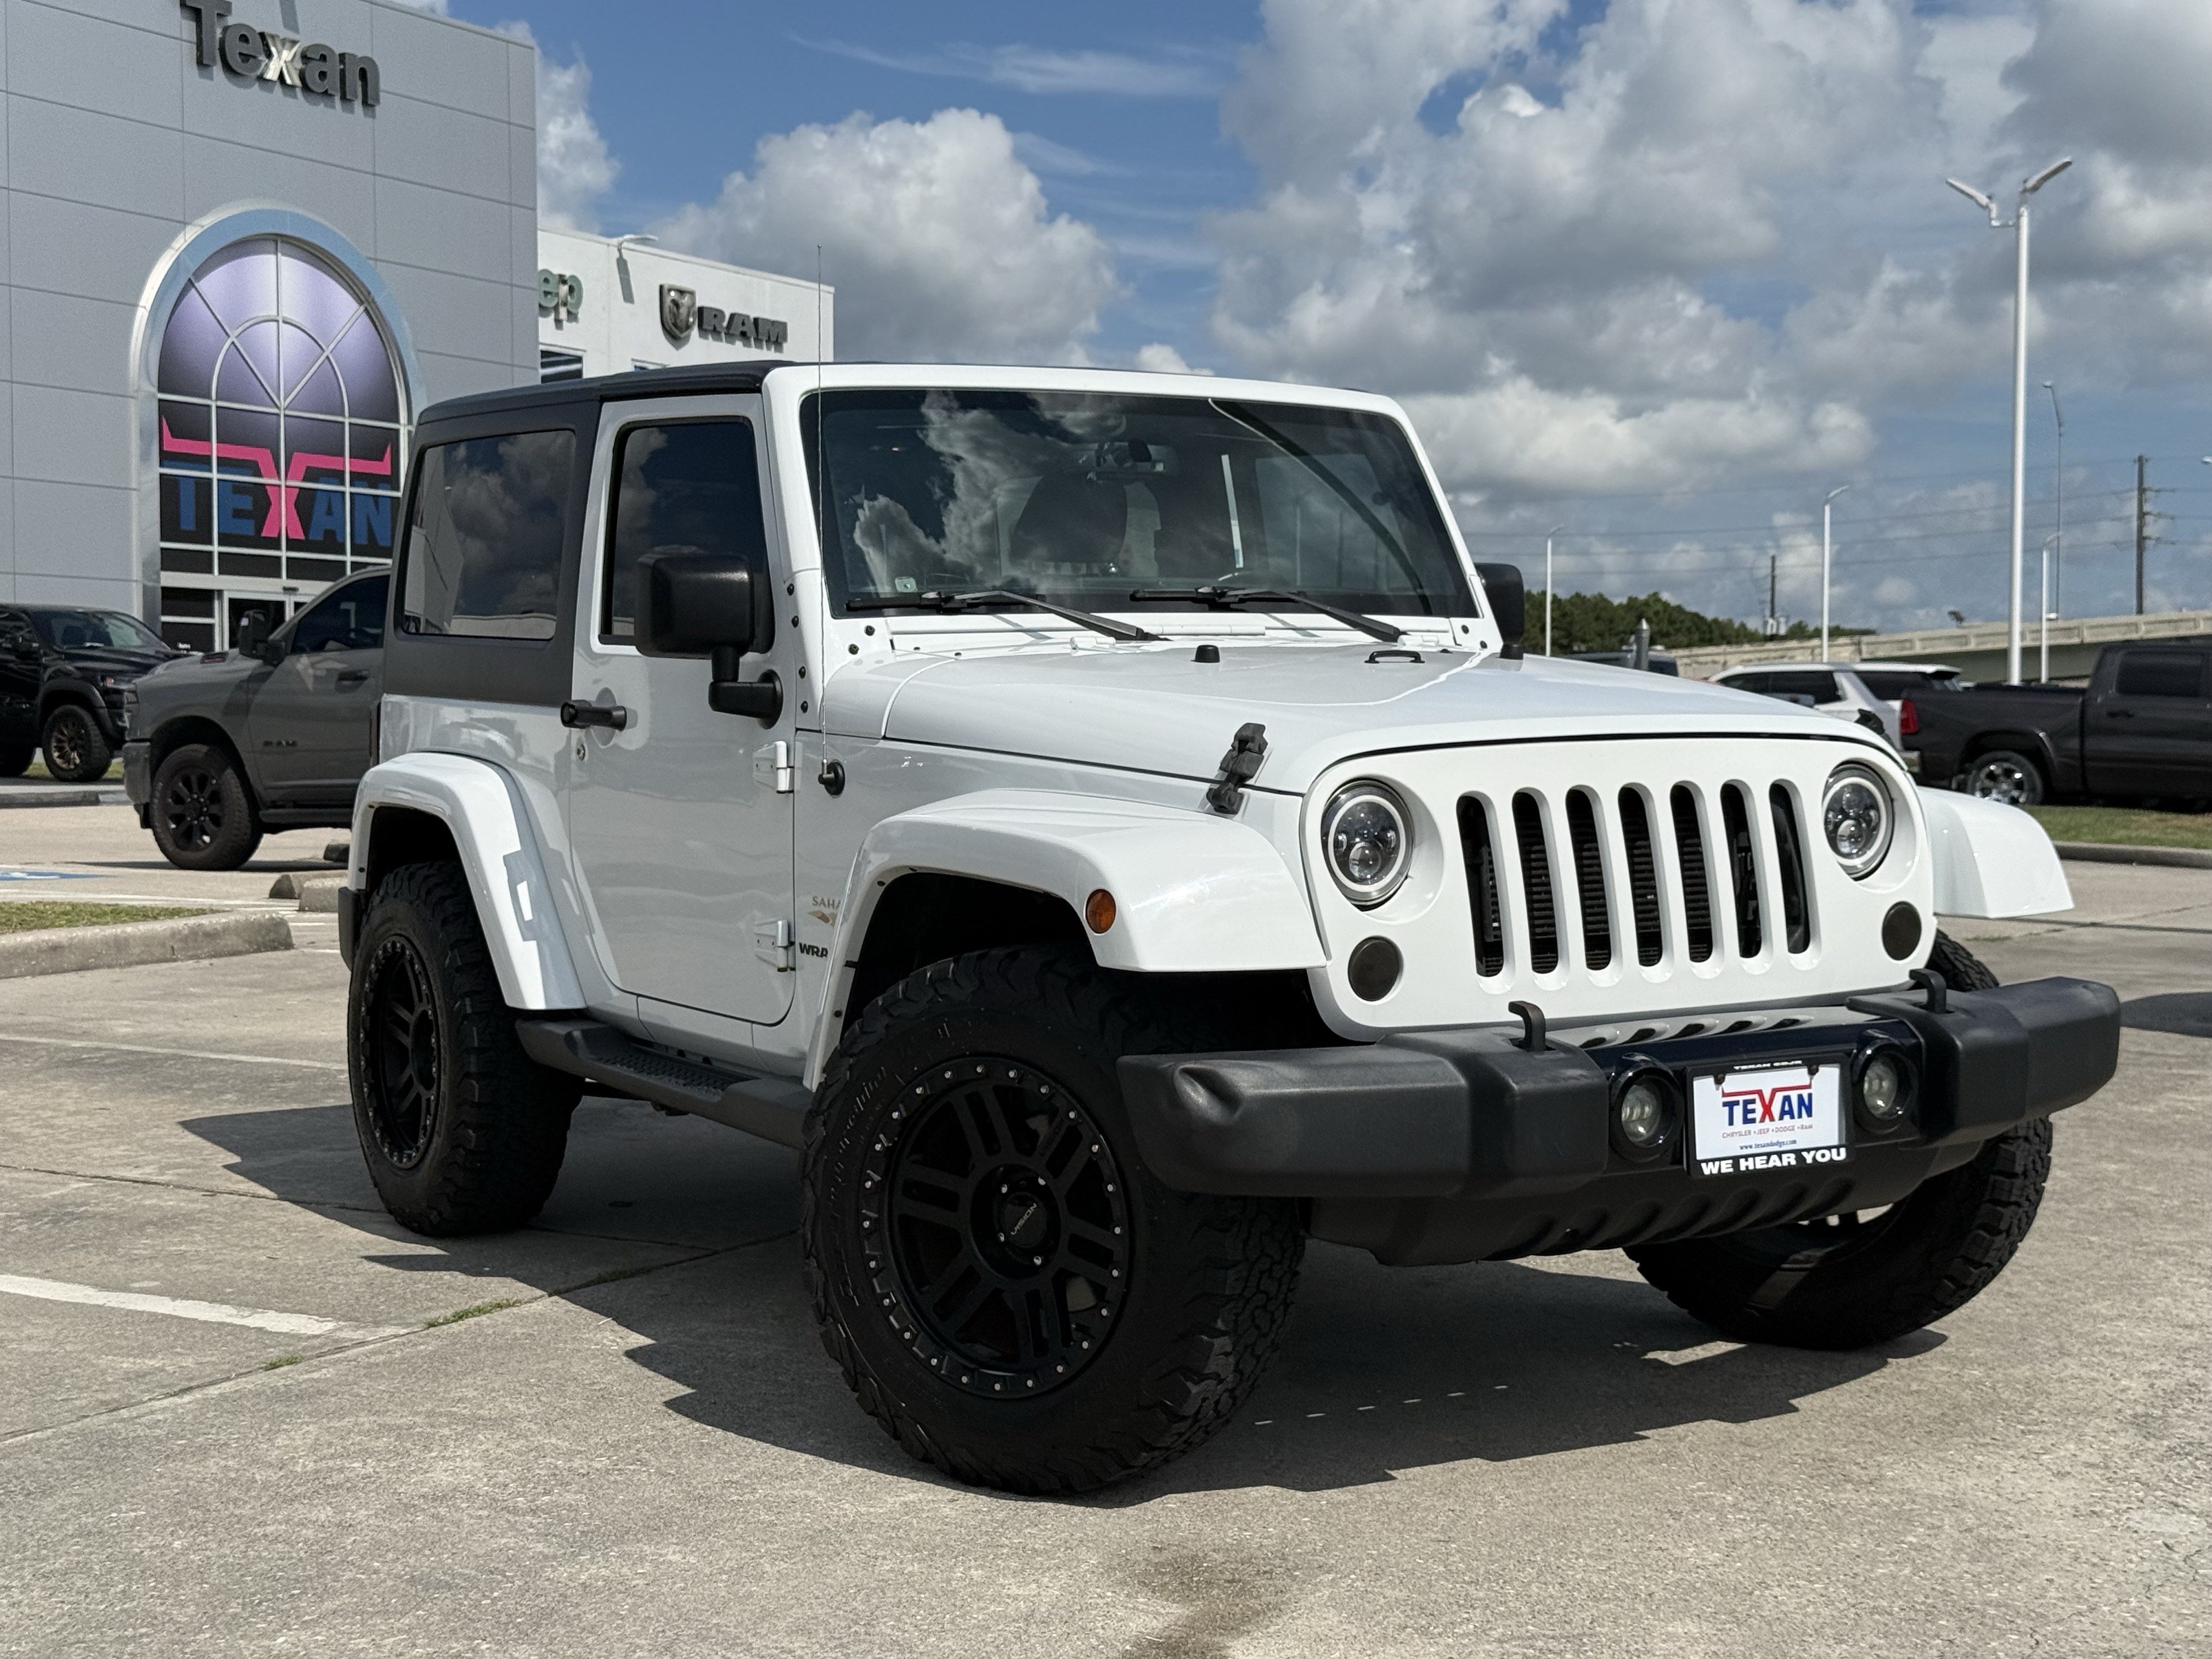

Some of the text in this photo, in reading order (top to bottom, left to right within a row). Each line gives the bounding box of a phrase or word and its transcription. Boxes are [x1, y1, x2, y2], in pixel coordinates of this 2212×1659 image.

[182, 0, 381, 105] Texan
[538, 269, 583, 321] ep
[697, 306, 788, 343] RAM
[161, 415, 392, 548] TEXAN
[799, 942, 829, 958] WRA
[1722, 1080, 1813, 1126] TEXAN
[1722, 1130, 1751, 1138] CHRYSLER
[1701, 1148, 1847, 1175] WE HEAR YOU
[1011, 1203, 1037, 1235] VISION
